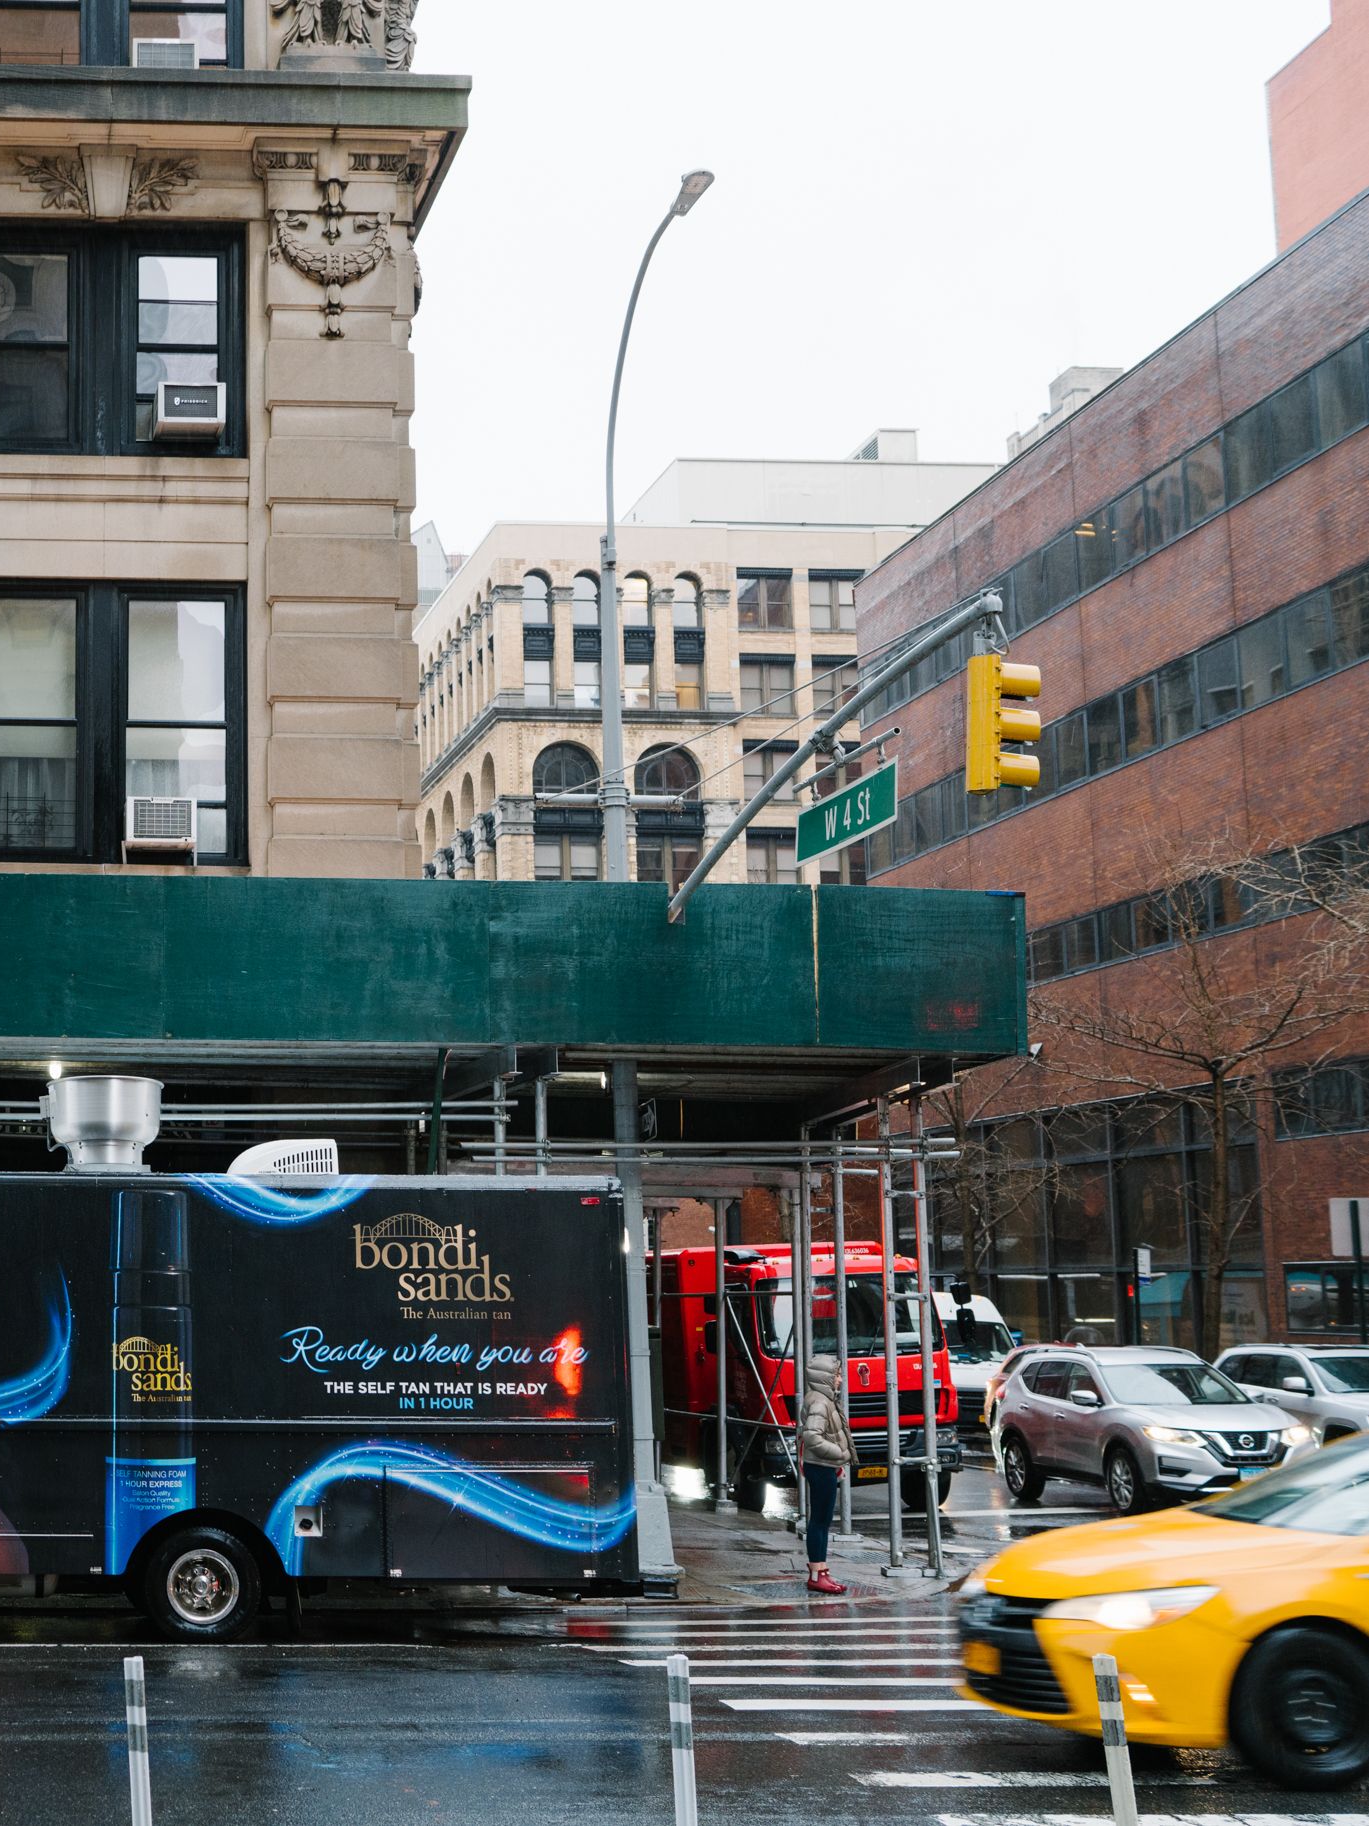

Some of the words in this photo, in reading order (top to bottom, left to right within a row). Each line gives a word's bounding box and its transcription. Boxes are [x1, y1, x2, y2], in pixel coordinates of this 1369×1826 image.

[825, 805, 837, 840] W
[843, 798, 851, 831] 4
[857, 787, 870, 825] St
[353, 1223, 480, 1270] bondi
[397, 1254, 512, 1302] sands
[400, 1307, 423, 1319] The
[427, 1307, 488, 1320] Australian
[492, 1310, 511, 1320] tan
[112, 1343, 180, 1372] bondi
[280, 1326, 386, 1373] Ready
[392, 1333, 473, 1365] when
[476, 1346, 535, 1371] you
[539, 1338, 589, 1365] are
[131, 1361, 192, 1391] sands
[131, 1393, 145, 1402] The
[324, 1381, 354, 1394] THE
[357, 1381, 395, 1394] SELF
[399, 1382, 430, 1394] TAN
[434, 1382, 474, 1394] THAT
[478, 1383, 492, 1395] IS
[495, 1383, 549, 1395] READY
[399, 1397, 414, 1409] IN
[418, 1397, 425, 1409] 1
[429, 1397, 474, 1410] HOUR
[116, 1469, 132, 1477] SELF
[133, 1470, 167, 1478] TANNING
[168, 1470, 187, 1478] FOAM
[125, 1480, 148, 1488] HOUR
[149, 1480, 183, 1488] EXPRESS
